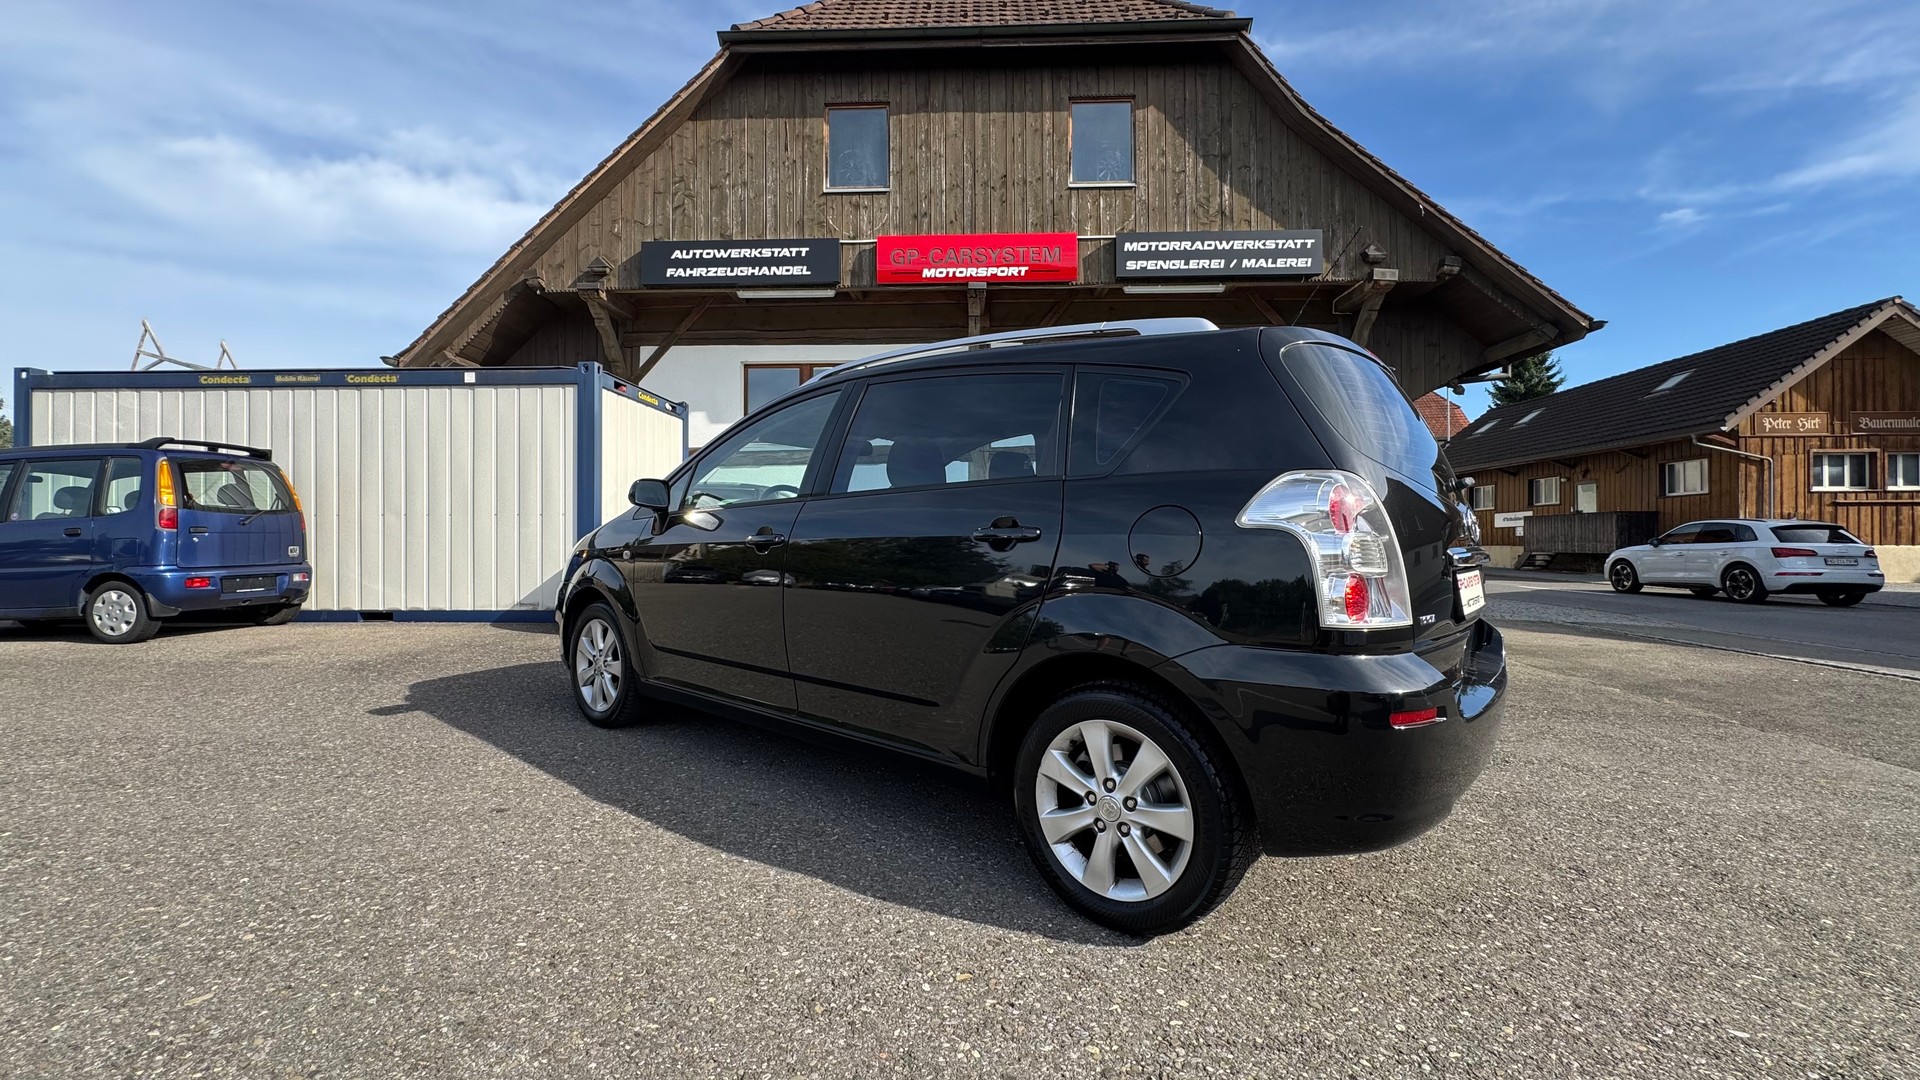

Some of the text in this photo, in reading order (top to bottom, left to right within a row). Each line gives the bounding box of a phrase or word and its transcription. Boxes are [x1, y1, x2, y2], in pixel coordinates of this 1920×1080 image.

[1123, 239, 1315, 252] MOTORRADWERKSTATT
[670, 247, 810, 260] AUTOWERKSTATT
[889, 246, 1062, 266] GP-CARSYSTEM
[1125, 257, 1312, 270] SPENGLEREI / MALEREI
[666, 265, 812, 278] FAHRZEUGHANDEL
[921, 266, 1029, 279] MOTORSPORT
[200, 375, 250, 384] Condecta
[347, 374, 398, 383] Condecta
[638, 391, 659, 406] Condecta
[1762, 417, 1821, 432] Peter Hirt
